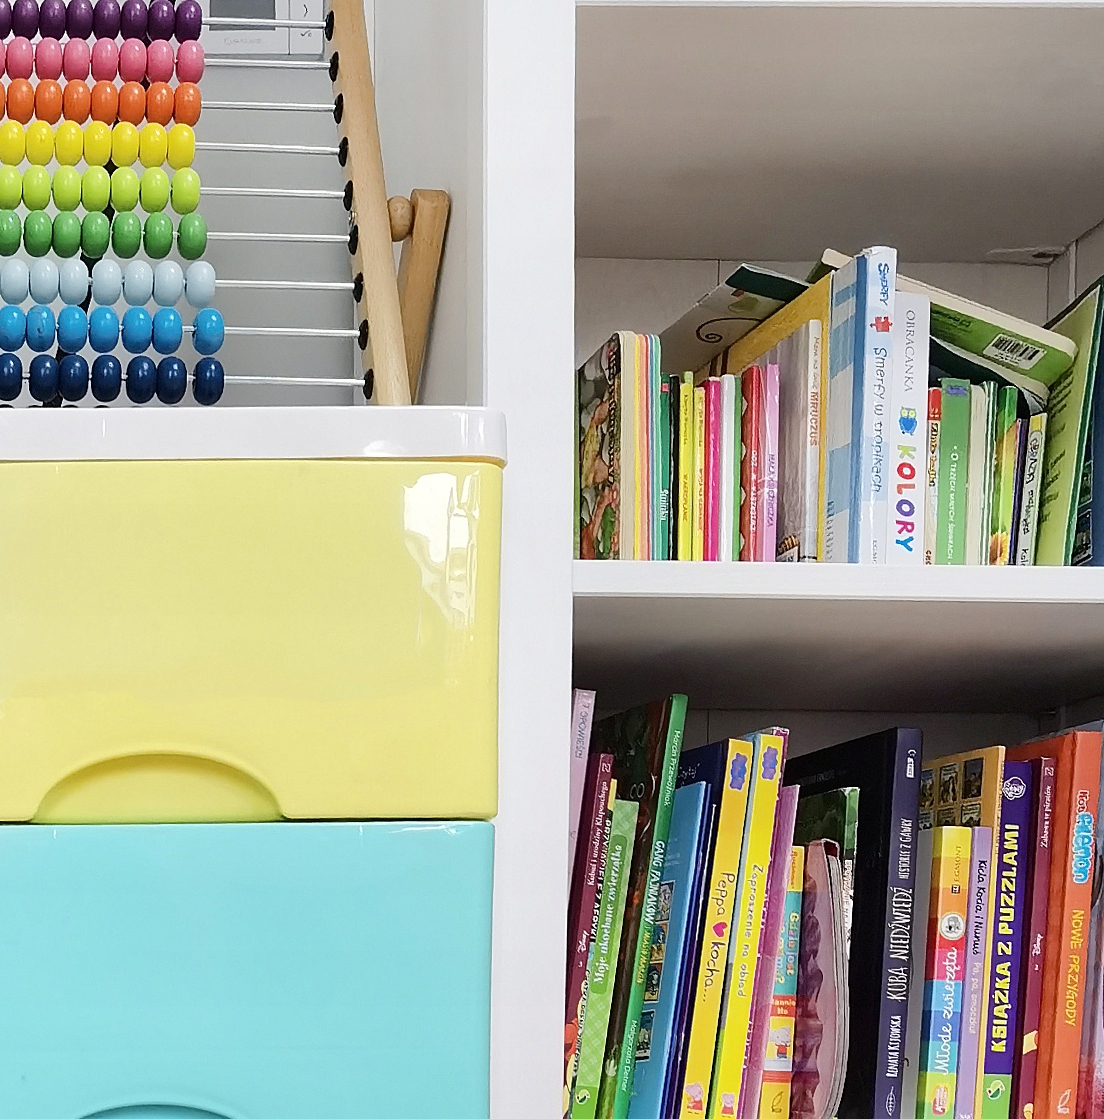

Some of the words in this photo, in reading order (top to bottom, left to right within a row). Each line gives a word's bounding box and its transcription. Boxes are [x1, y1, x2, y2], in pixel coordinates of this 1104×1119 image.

[903, 310, 917, 393] OBRACANKA
[872, 347, 888, 400] Smerfy
[874, 404, 885, 417] w
[871, 421, 885, 494] tropikach
[895, 445, 917, 553] KOLORY
[671, 730, 681, 757] Marcin
[653, 841, 665, 867] GANG
[953, 845, 961, 882] EGMONT
[977, 859, 988, 884] Kicia
[712, 872, 736, 916] Peppa
[998, 823, 1019, 935] PUZZLAMI
[744, 864, 764, 938] Zaproszenie
[974, 887, 987, 914] Kocia
[598, 903, 614, 954] ukochane
[888, 887, 913, 962] NIEDŹWIEDŹ
[1070, 909, 1085, 949] NOWE
[742, 944, 750, 957] na
[997, 941, 1012, 956] Z
[593, 956, 609, 985] Moje
[737, 964, 749, 997] obiad
[887, 967, 909, 1003] KUBA
[937, 945, 961, 1019] zwierzęta
[1065, 955, 1080, 1027] PRZYGODY
[991, 961, 1012, 1053] KSIĄŻKA
[885, 1051, 900, 1078] RENATA
[934, 1021, 953, 1075] Młode
